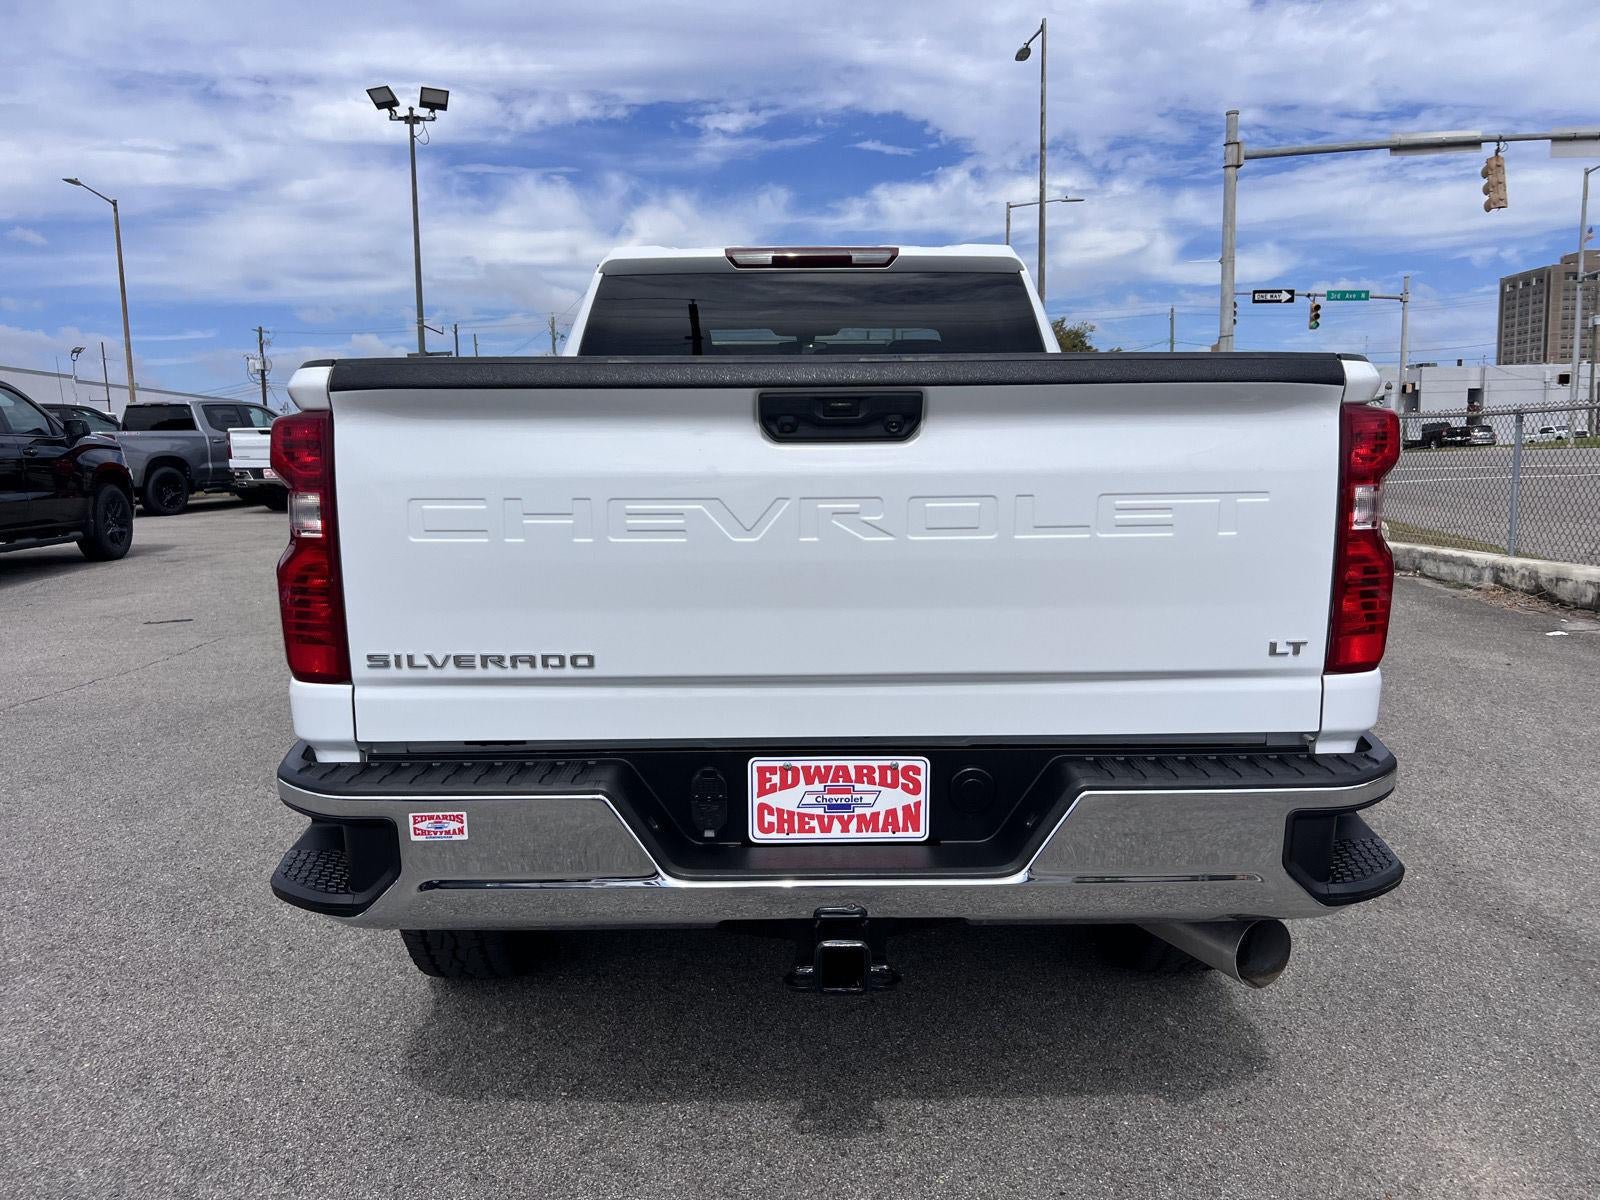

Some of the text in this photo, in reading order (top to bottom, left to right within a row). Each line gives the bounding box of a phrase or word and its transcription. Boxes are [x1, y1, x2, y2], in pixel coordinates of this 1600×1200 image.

[1330, 292, 1341, 300] 3rd
[1345, 292, 1357, 300] Ave
[407, 491, 1270, 542] CHEVROLET
[1269, 641, 1308, 656] LT
[366, 653, 595, 669] SILVERADO
[757, 764, 922, 798] EDWARDS
[815, 794, 863, 804] Chevrolet
[412, 814, 464, 825] EDWARDS
[757, 800, 922, 835] CHEVYMAN
[413, 826, 465, 836] CHEVYMAN
